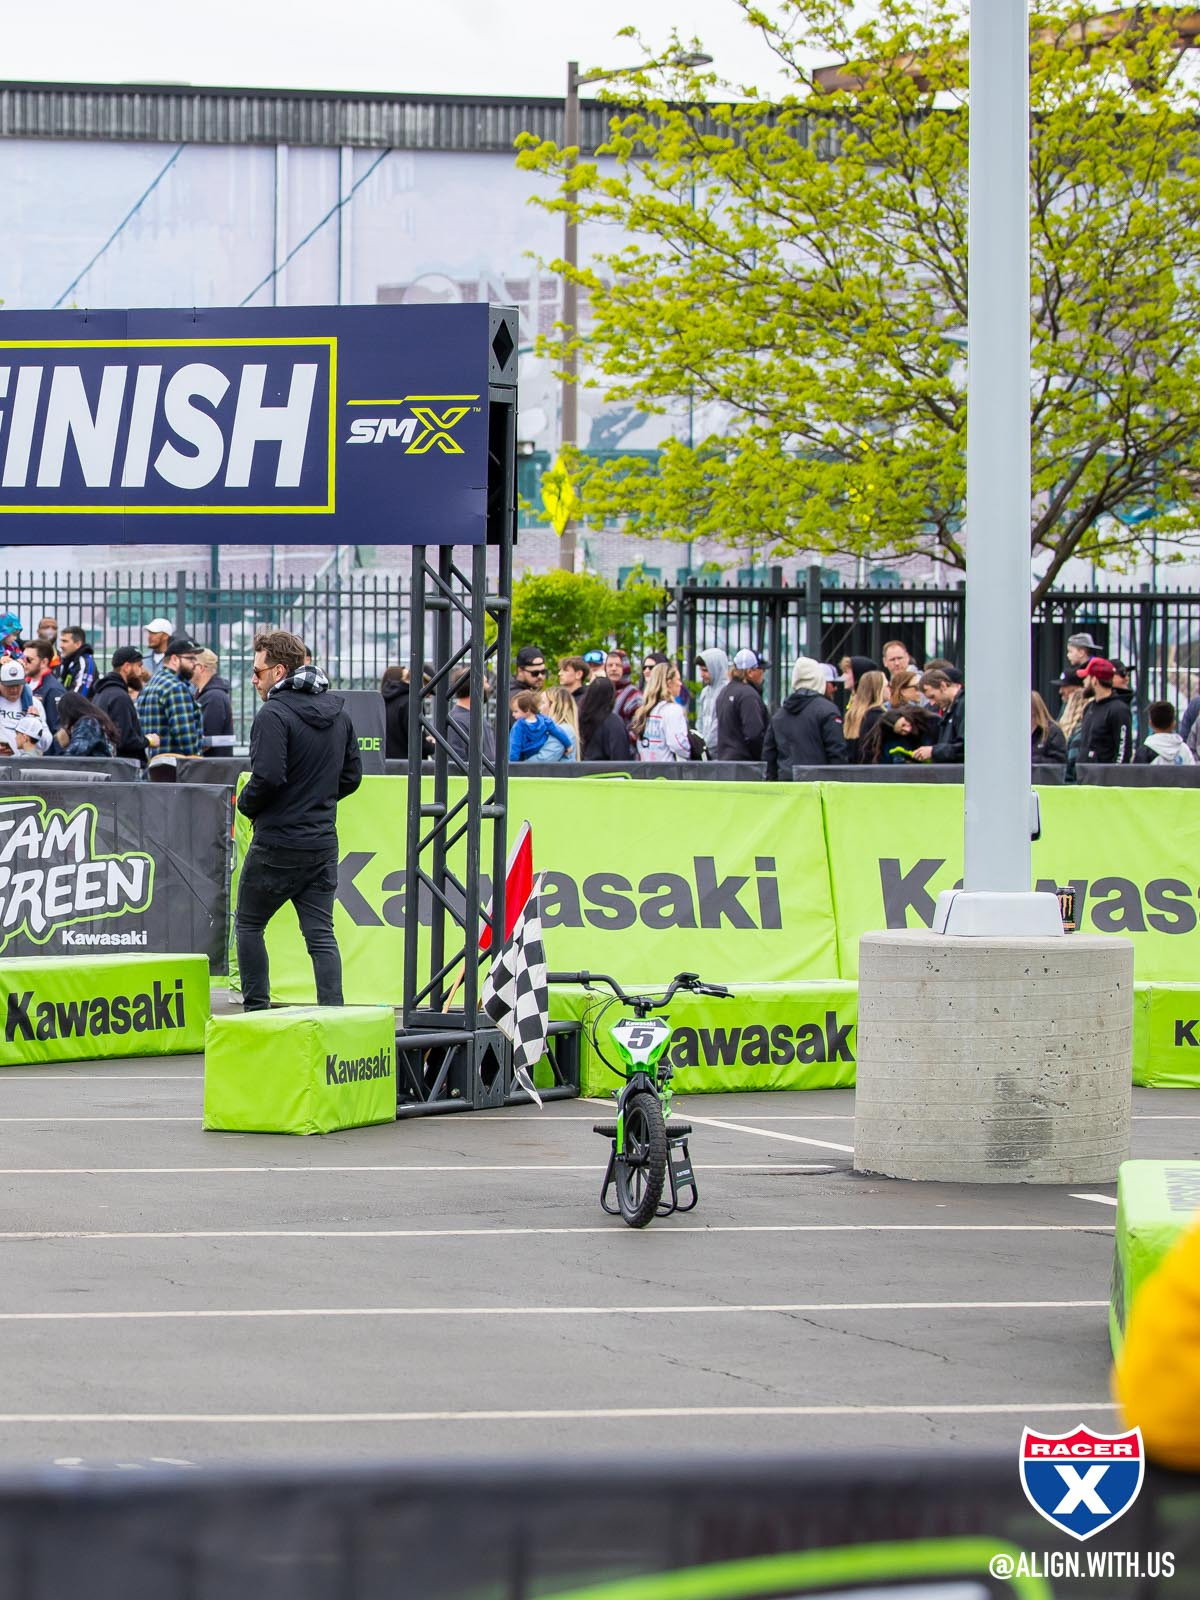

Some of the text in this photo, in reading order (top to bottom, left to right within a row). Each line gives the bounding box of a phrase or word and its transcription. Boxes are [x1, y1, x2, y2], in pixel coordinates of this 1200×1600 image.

[62, 929, 148, 947] Kawasaki
[5, 978, 186, 1043] Kawasaki
[627, 1027, 655, 1050] 5
[658, 1011, 856, 1067] awasak
[326, 1047, 391, 1086] Kawasaki
